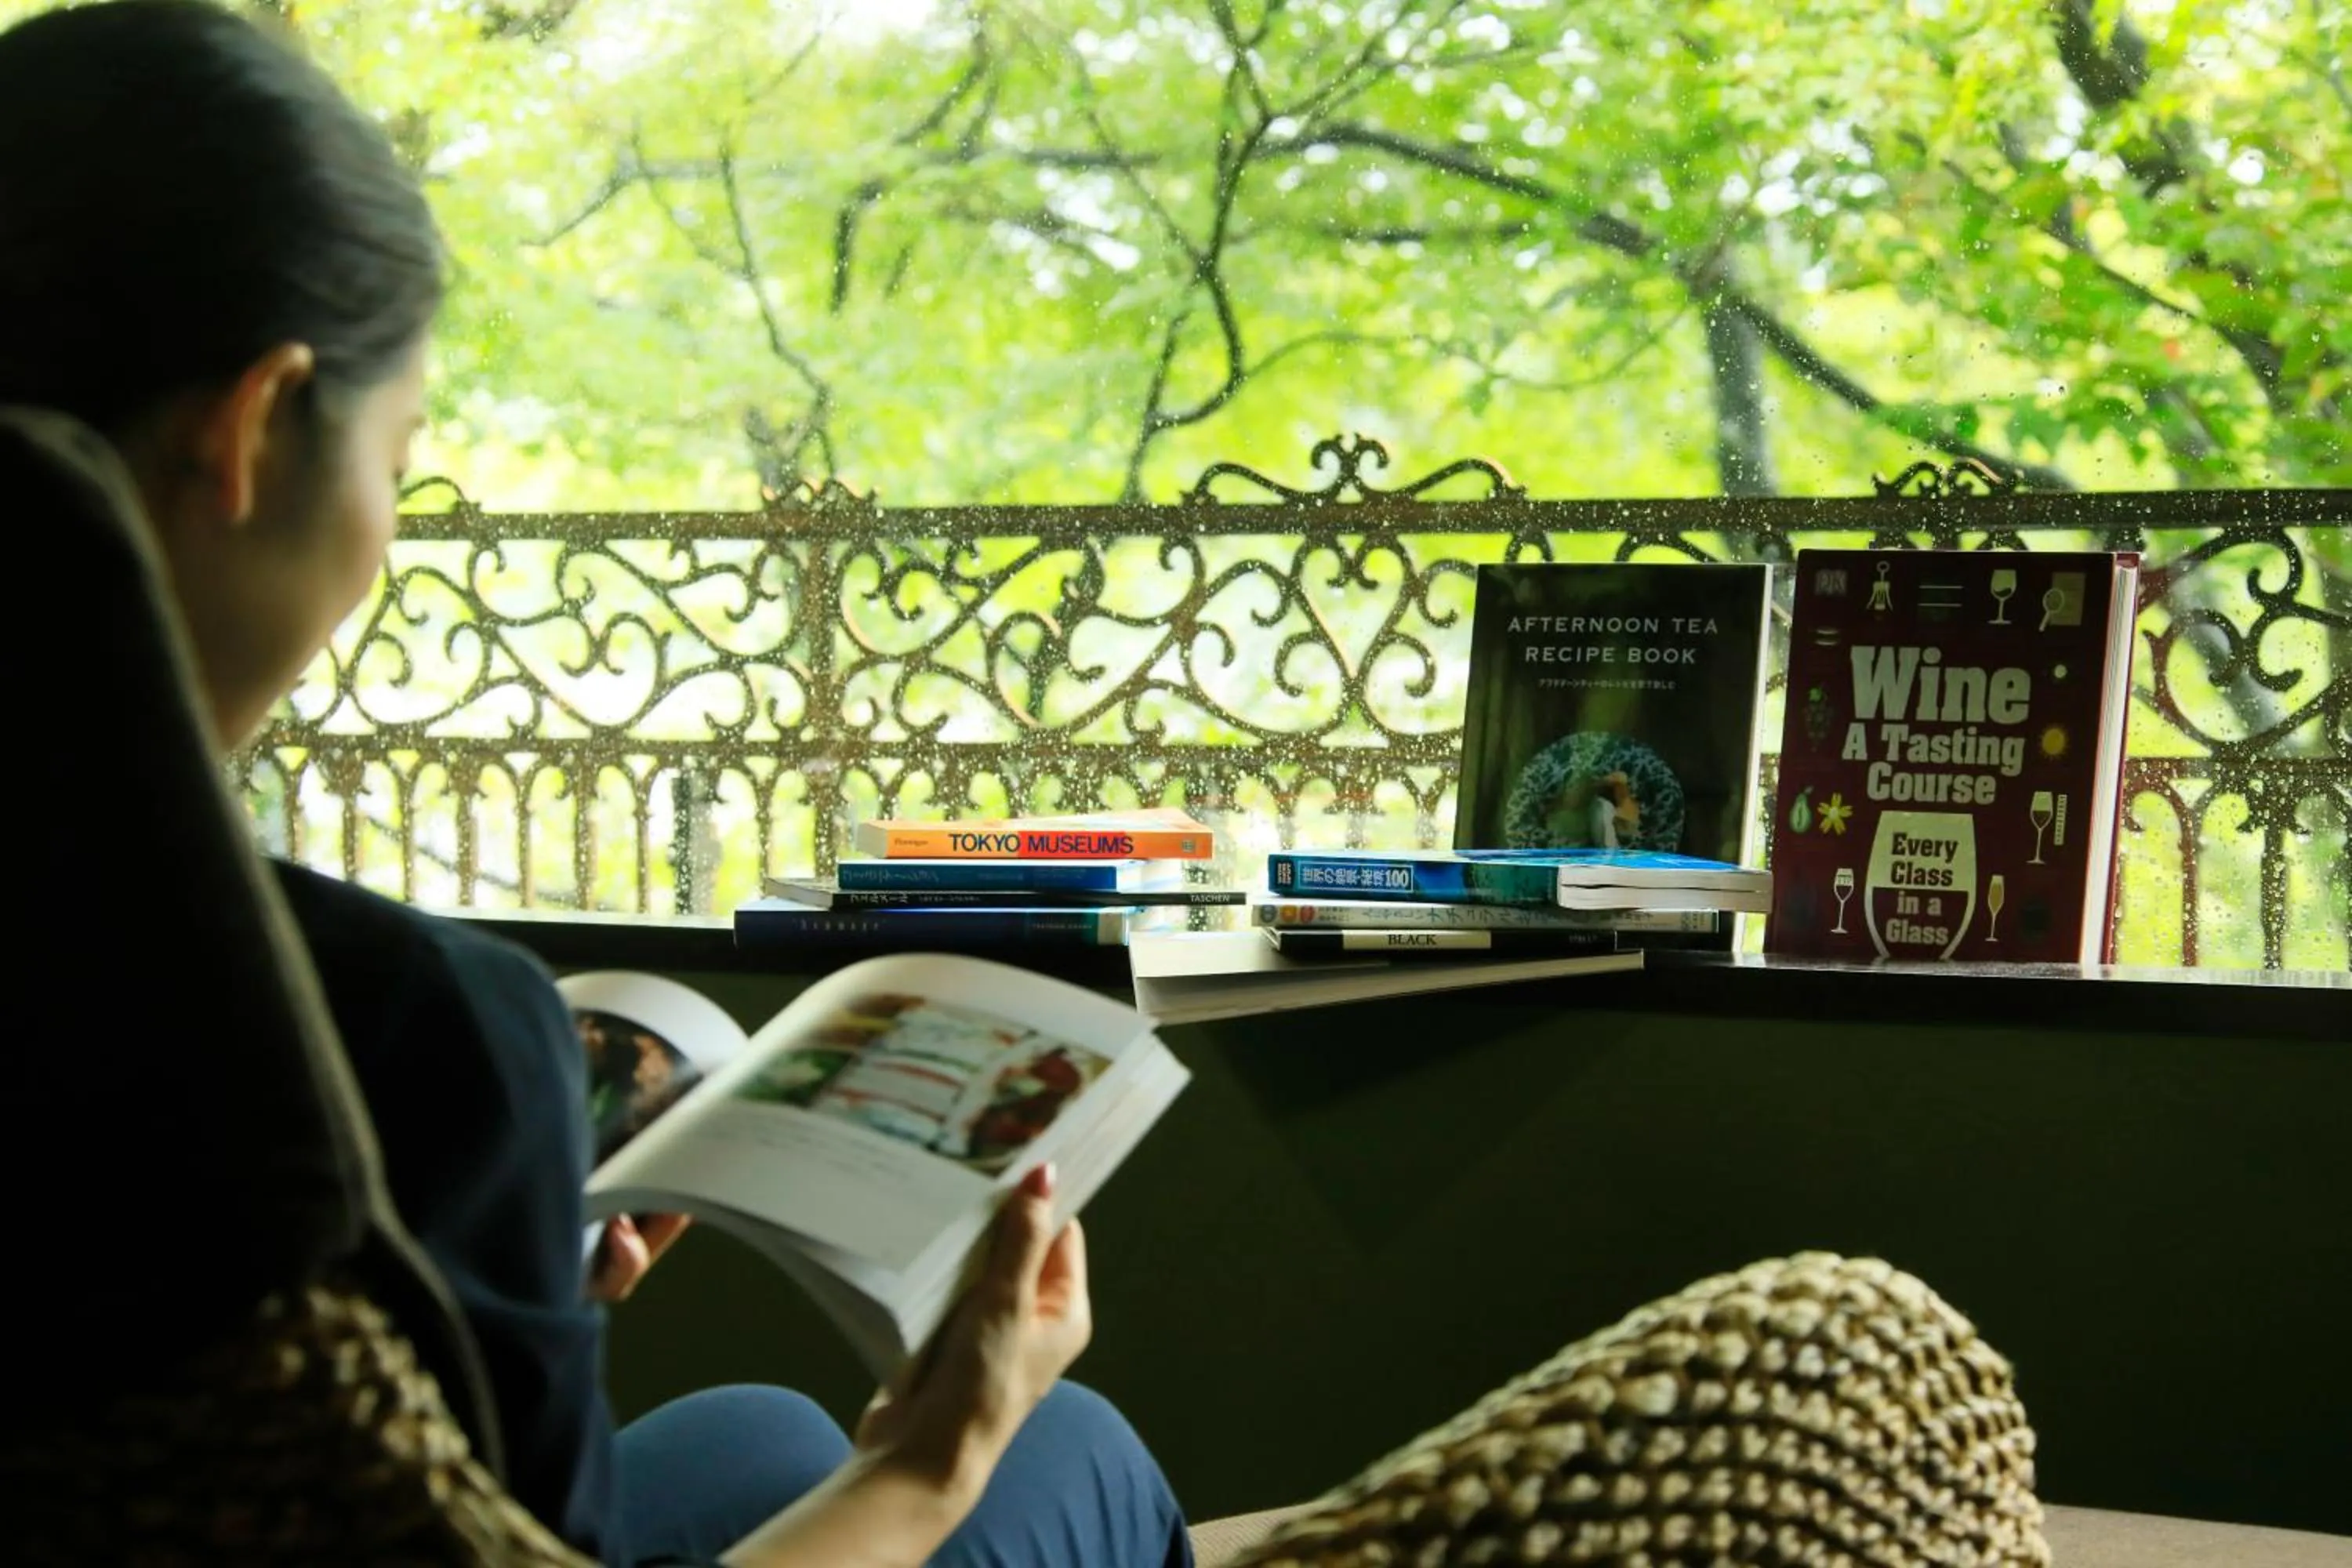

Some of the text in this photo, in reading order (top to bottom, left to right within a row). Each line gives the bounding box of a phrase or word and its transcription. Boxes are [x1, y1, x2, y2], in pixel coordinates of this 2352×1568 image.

[1507, 616, 1719, 634] AFTERNOON TEA
[1525, 647, 1696, 664] RECIPE BOOK
[1850, 644, 2031, 724] Wine
[1842, 722, 2025, 777] A Tasting
[1867, 761, 1996, 804] Course
[948, 833, 1021, 853] TOKYO
[1028, 833, 1134, 855] MUSEUMS
[1892, 832, 1958, 862] Every
[1890, 861, 1953, 887] Class
[1190, 895, 1230, 903] TASCHEN
[1897, 890, 1942, 916] in a
[1388, 934, 1437, 946] BLACK
[1886, 919, 1949, 946] Glass
